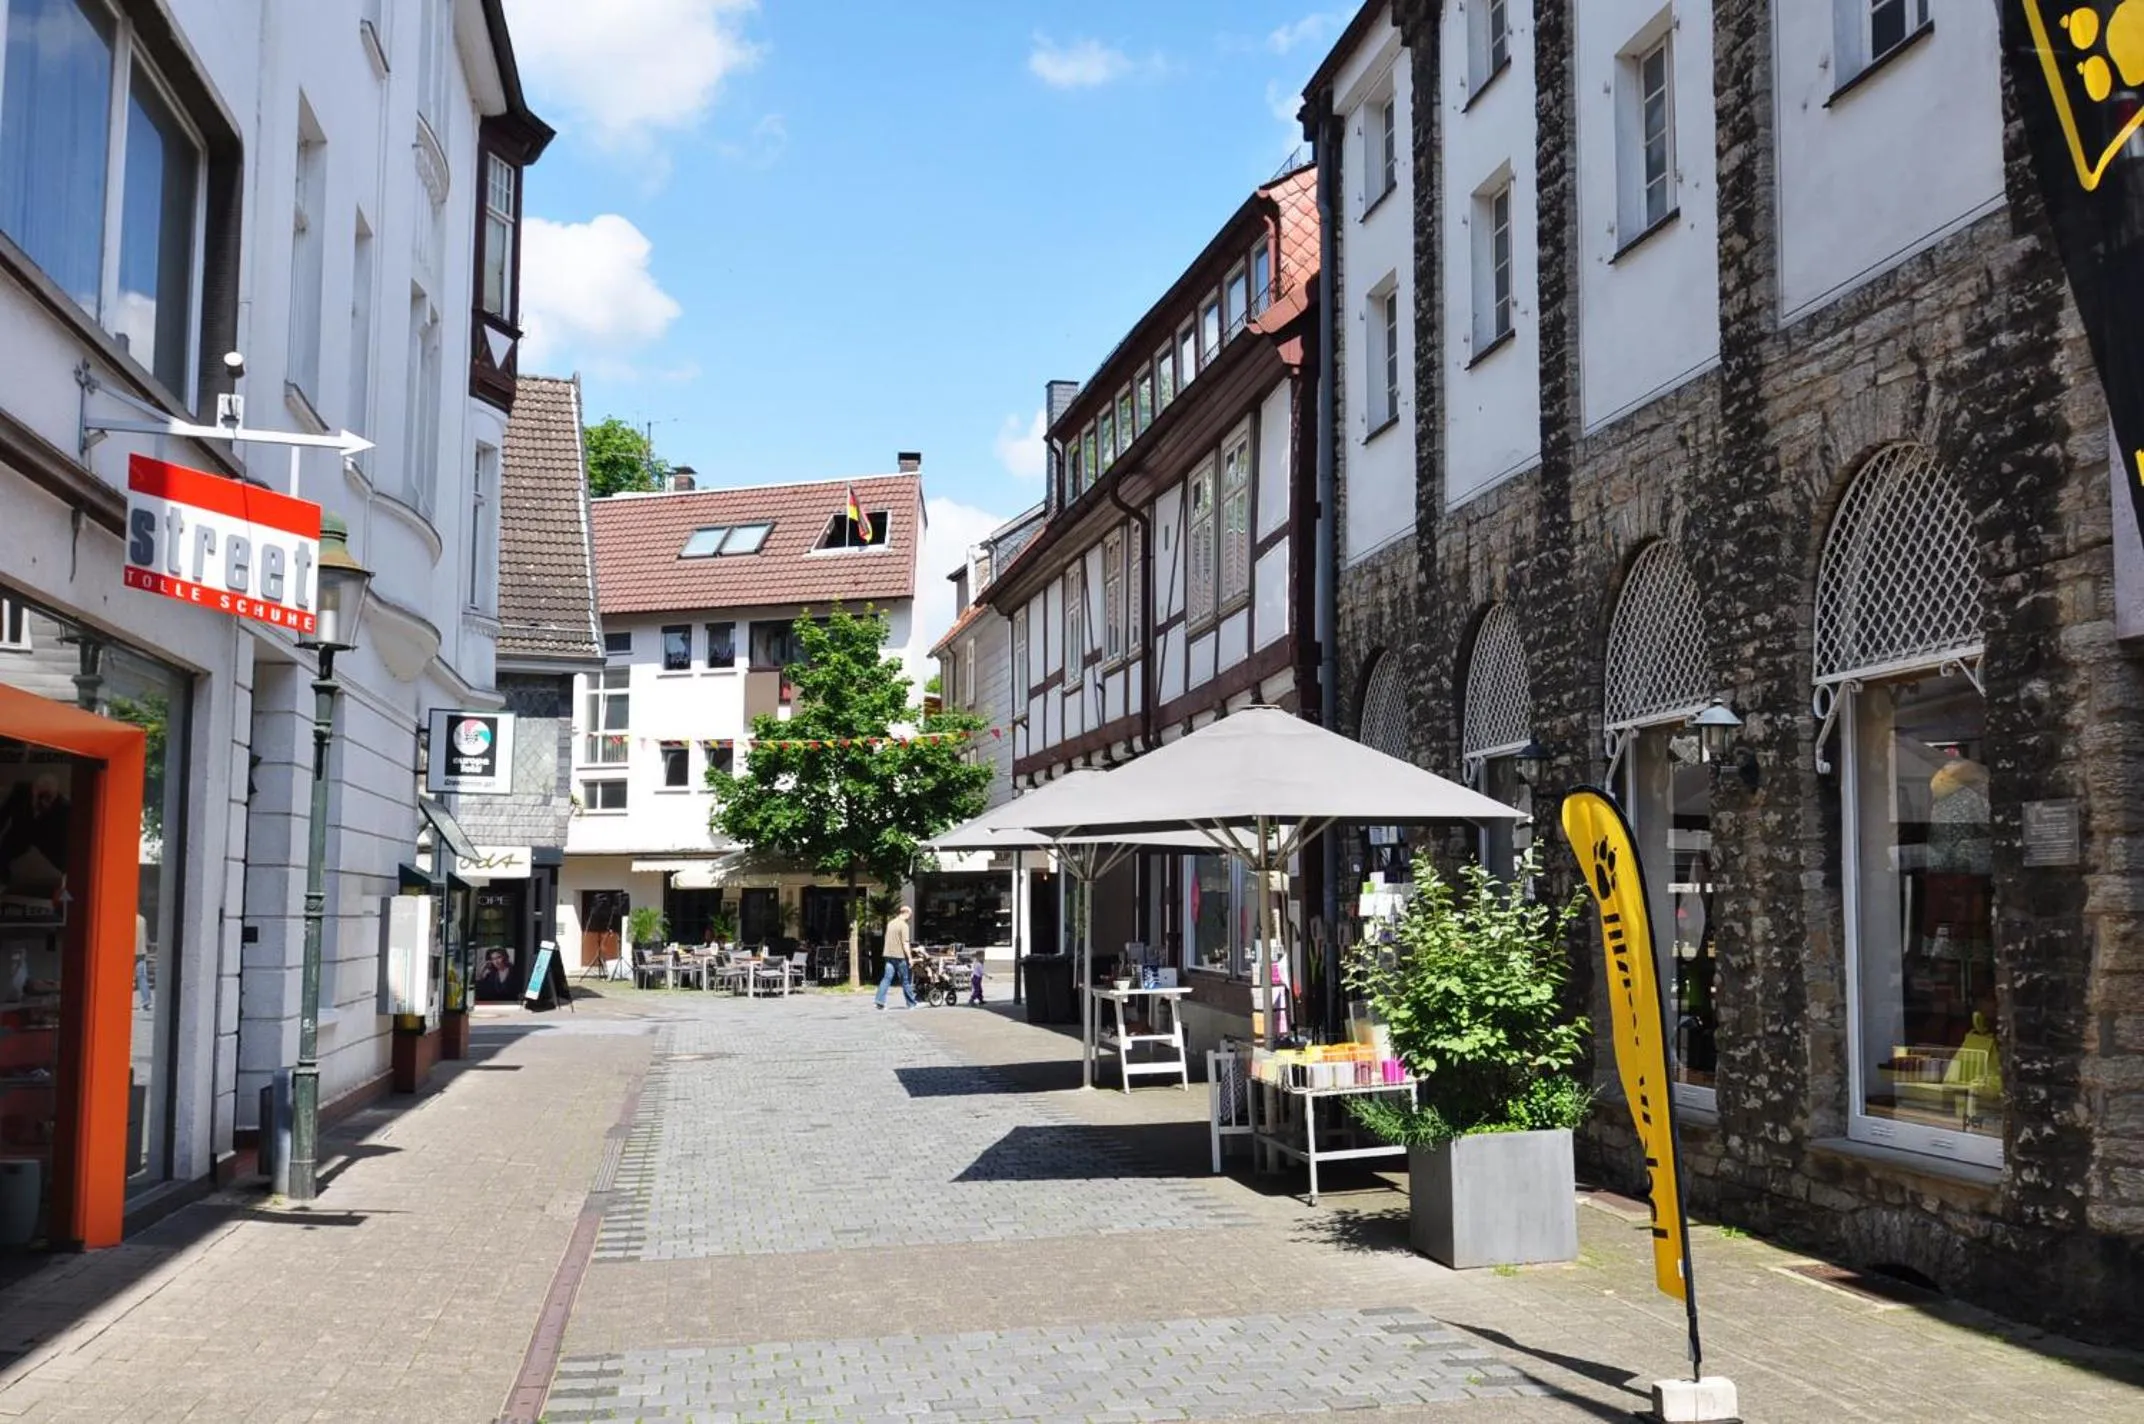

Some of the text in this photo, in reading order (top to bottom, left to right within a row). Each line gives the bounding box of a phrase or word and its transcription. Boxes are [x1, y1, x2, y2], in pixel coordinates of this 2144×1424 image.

[126, 569, 315, 631] TOLLE SCHUHE
[130, 507, 312, 611] street
